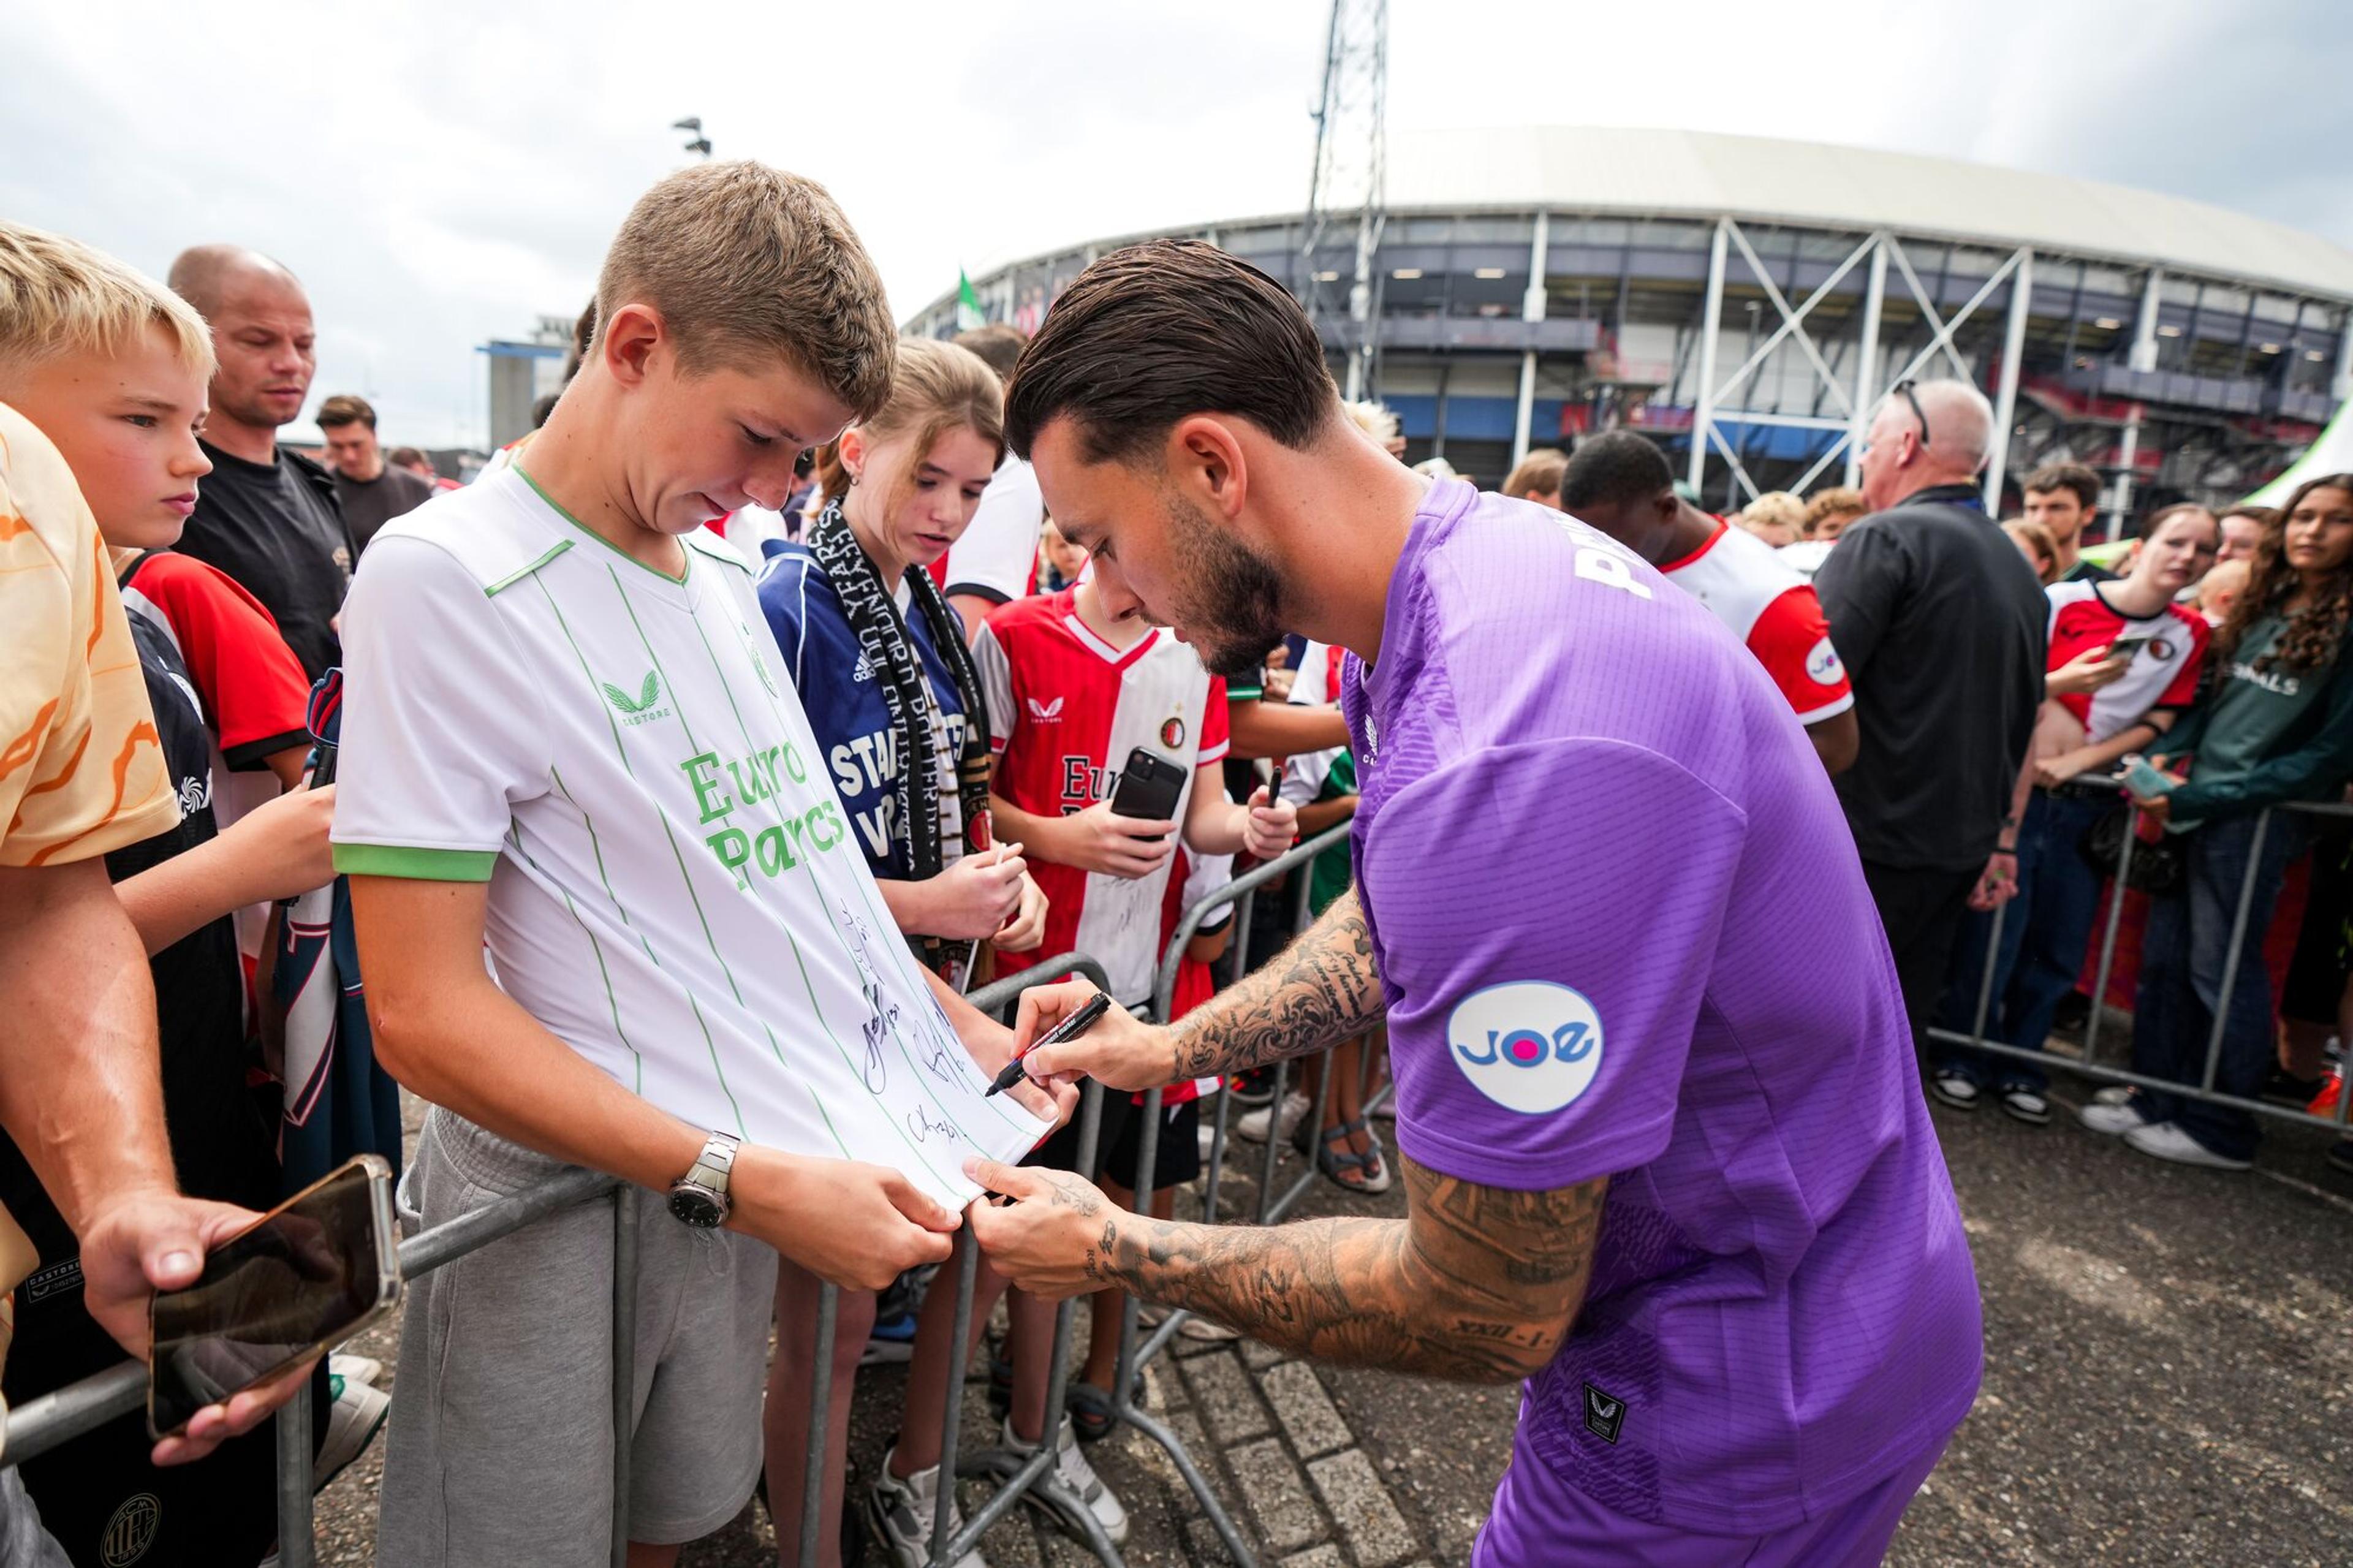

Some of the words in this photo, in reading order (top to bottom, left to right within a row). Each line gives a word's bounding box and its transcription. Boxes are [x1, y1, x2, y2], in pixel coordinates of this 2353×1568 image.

[680, 741, 807, 826] Euro
[1062, 755, 1123, 800] Eur
[706, 800, 845, 891] Parcs
